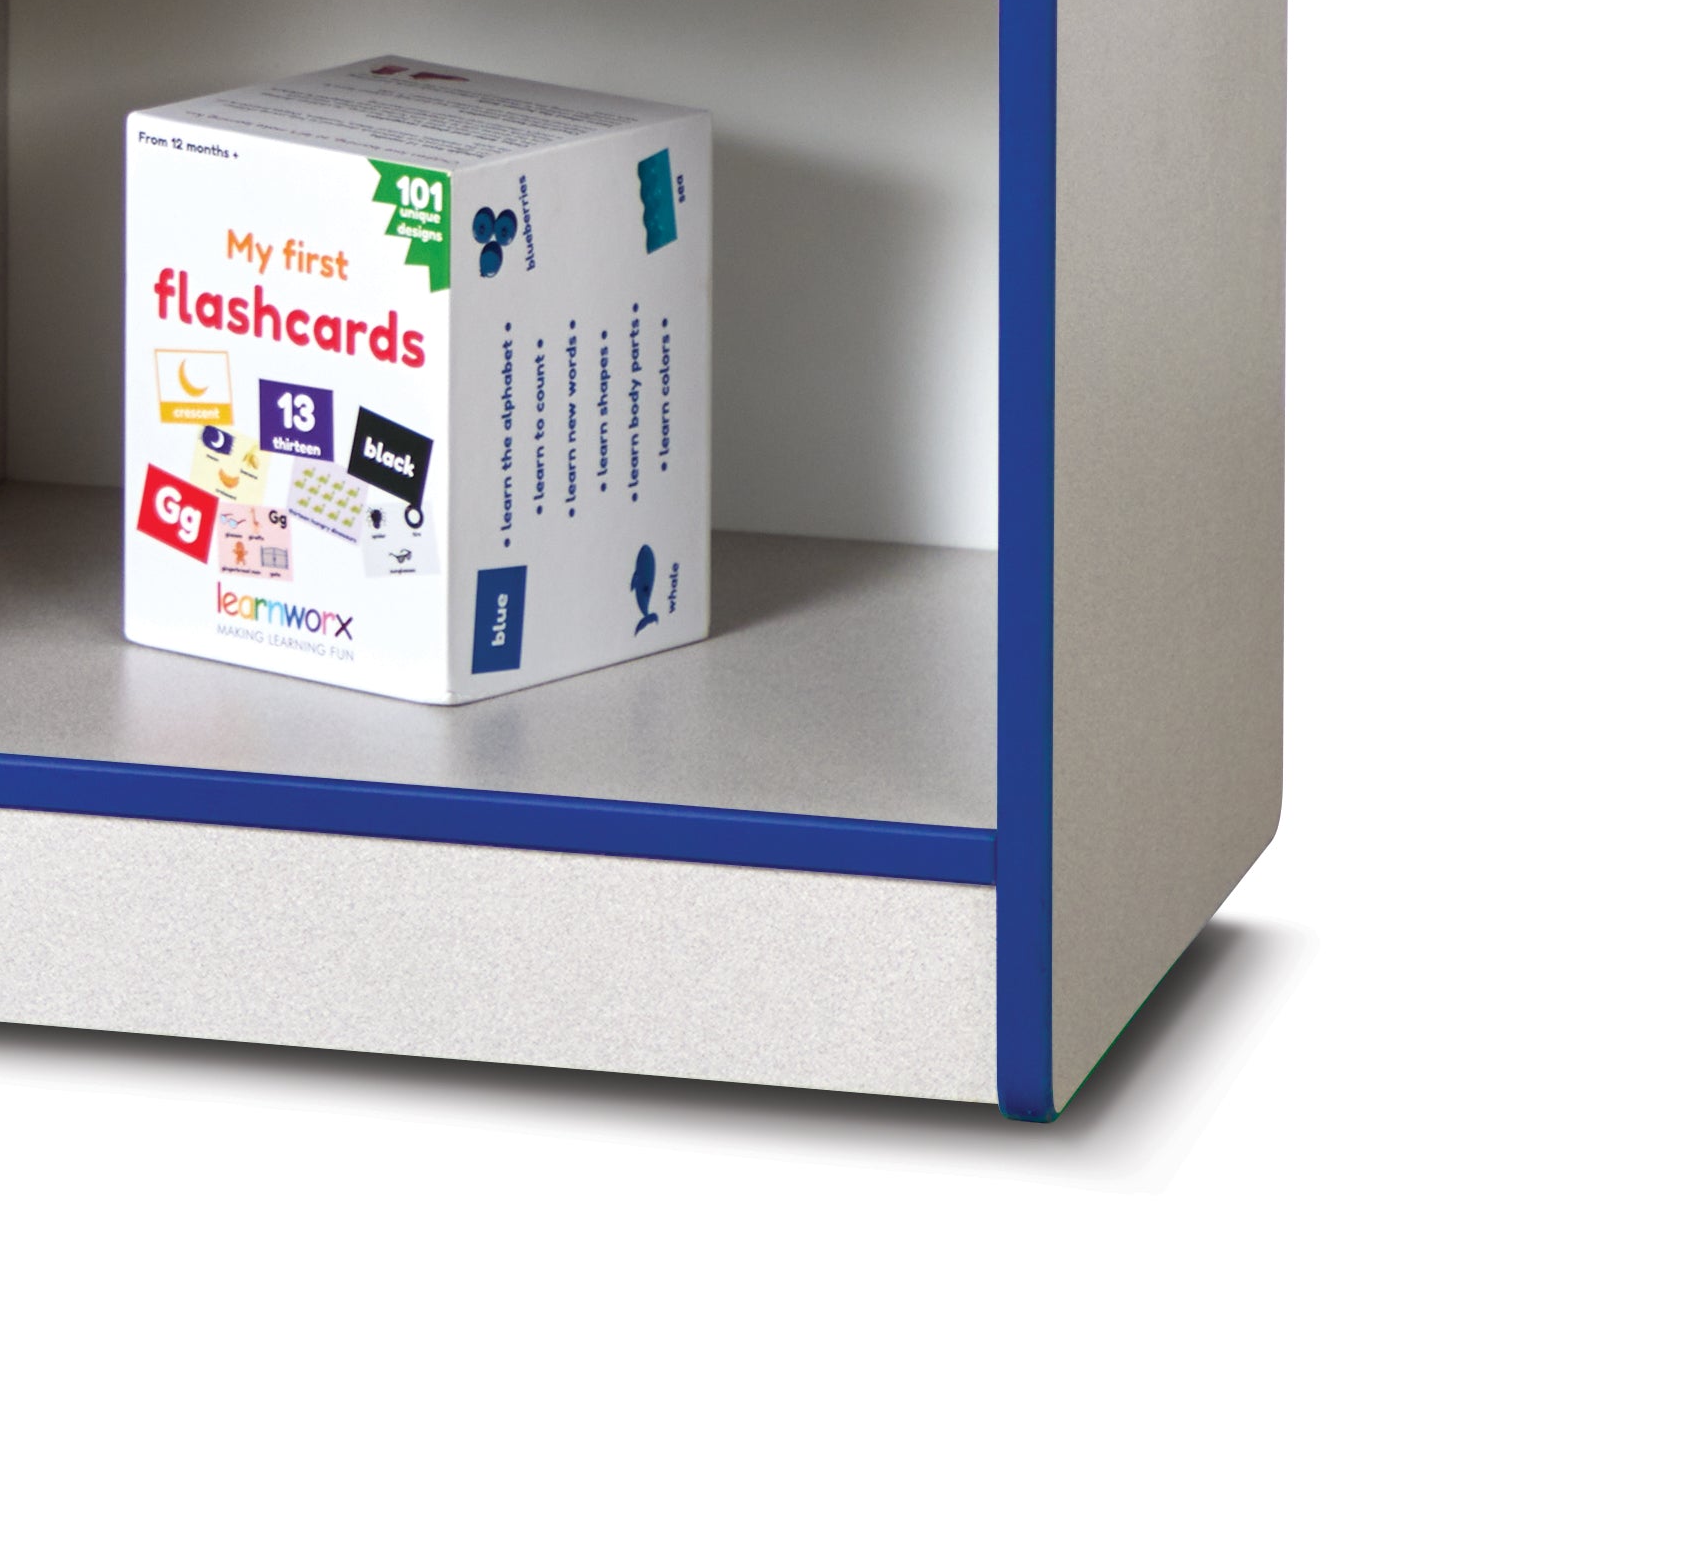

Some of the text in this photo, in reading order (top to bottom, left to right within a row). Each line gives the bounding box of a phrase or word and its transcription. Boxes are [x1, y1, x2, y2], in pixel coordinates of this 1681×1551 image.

[138, 131, 169, 149] From
[171, 135, 184, 150] 12
[186, 141, 230, 159] months
[396, 175, 444, 212] 101
[676, 174, 686, 203] sea
[396, 224, 444, 243] designs
[399, 207, 442, 225] unique
[518, 174, 536, 272] blueberries
[227, 228, 350, 281] My first
[153, 267, 427, 369] flashcards
[172, 407, 221, 421] crescent
[276, 392, 316, 433] 13
[565, 335, 577, 503] learn new words
[597, 346, 611, 477] learn shapes
[628, 318, 642, 488] learn body parts
[659, 333, 671, 457] learn colors
[272, 436, 322, 457] thirteen
[500, 339, 515, 531] learn the alphabet
[533, 353, 546, 501] learn to count
[363, 436, 416, 479] black
[155, 485, 203, 544] Gg
[268, 510, 288, 529] Gg
[216, 581, 354, 641] learnworx
[668, 562, 680, 614] whale
[216, 623, 355, 662] MAKING LEARNING FUN
[491, 593, 509, 647] blue
